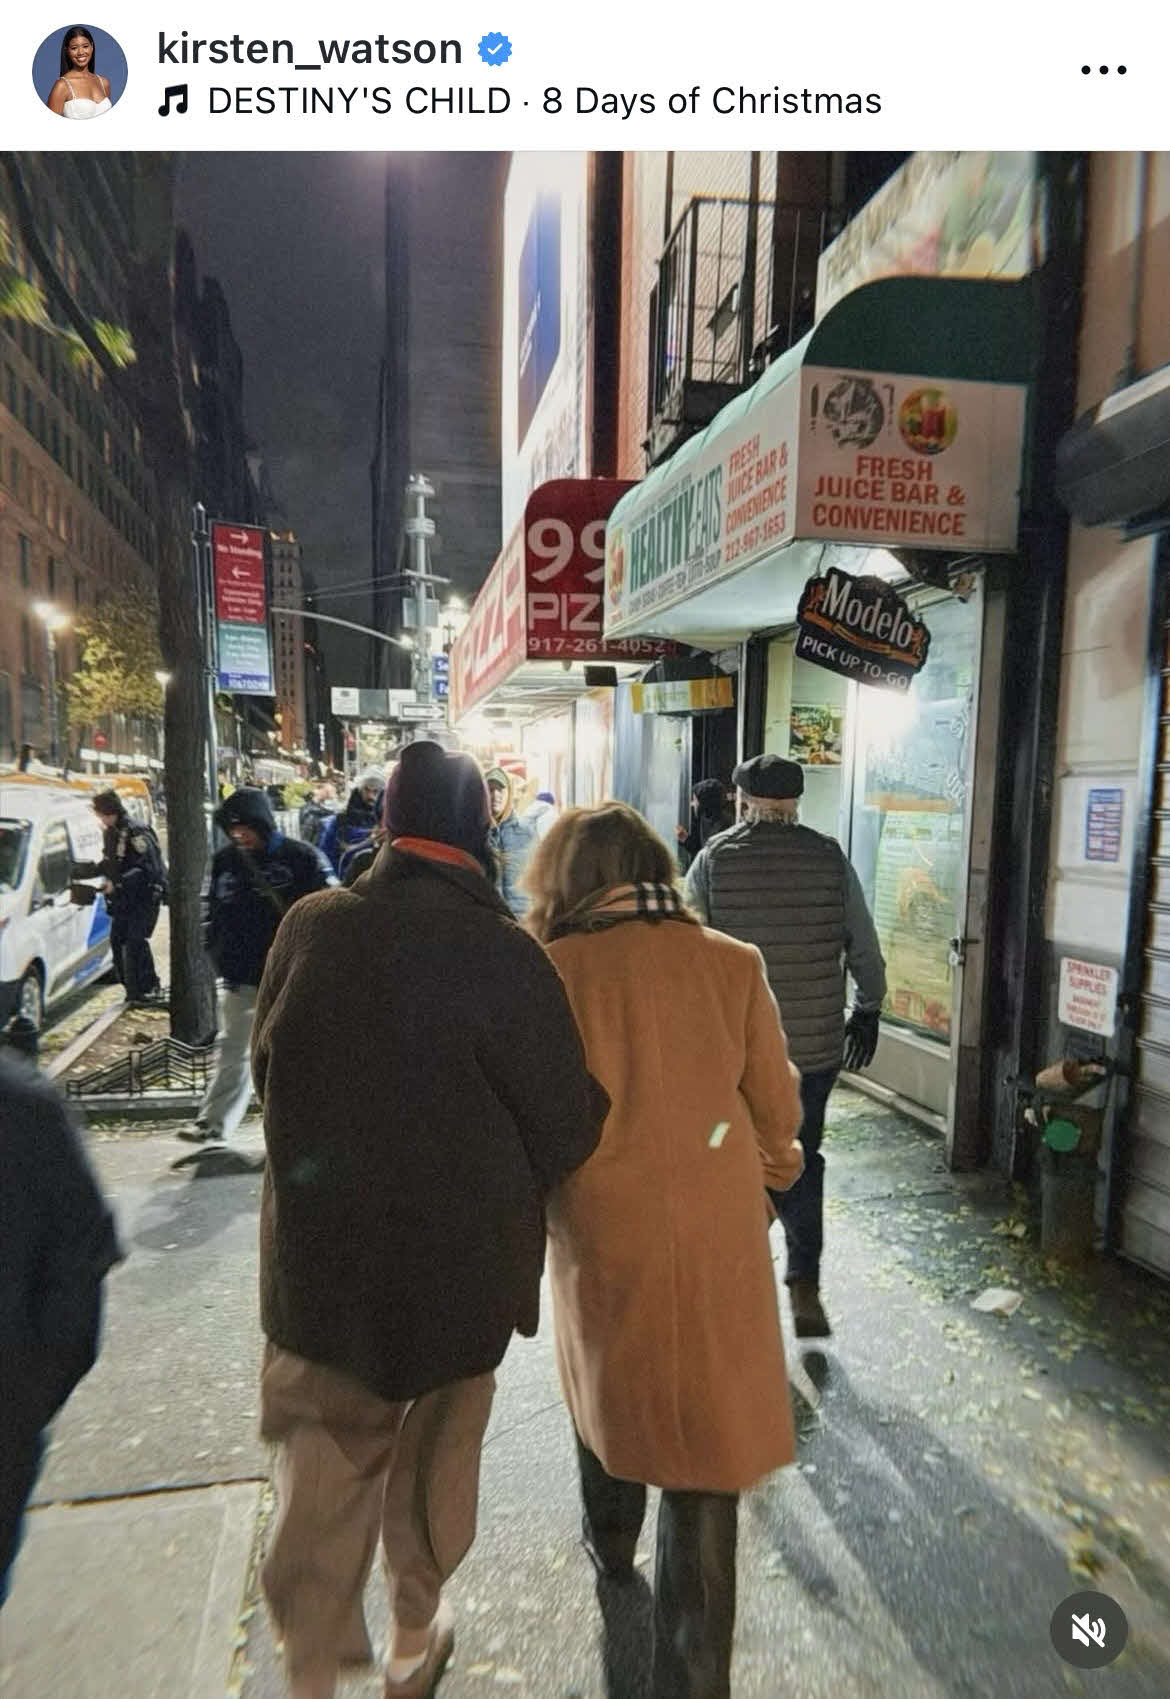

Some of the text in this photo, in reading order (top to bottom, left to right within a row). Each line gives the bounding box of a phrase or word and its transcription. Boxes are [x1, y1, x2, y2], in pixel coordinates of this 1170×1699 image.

[729, 434, 761, 476] FRESH
[756, 450, 778, 486] BAR
[855, 456, 934, 481] FRESH
[814, 476, 967, 505] JUICE BAR &
[812, 504, 968, 536] CONVENIENCE
[822, 574, 914, 648] Modelo
[802, 636, 908, 689] PICK UP TO-GO
